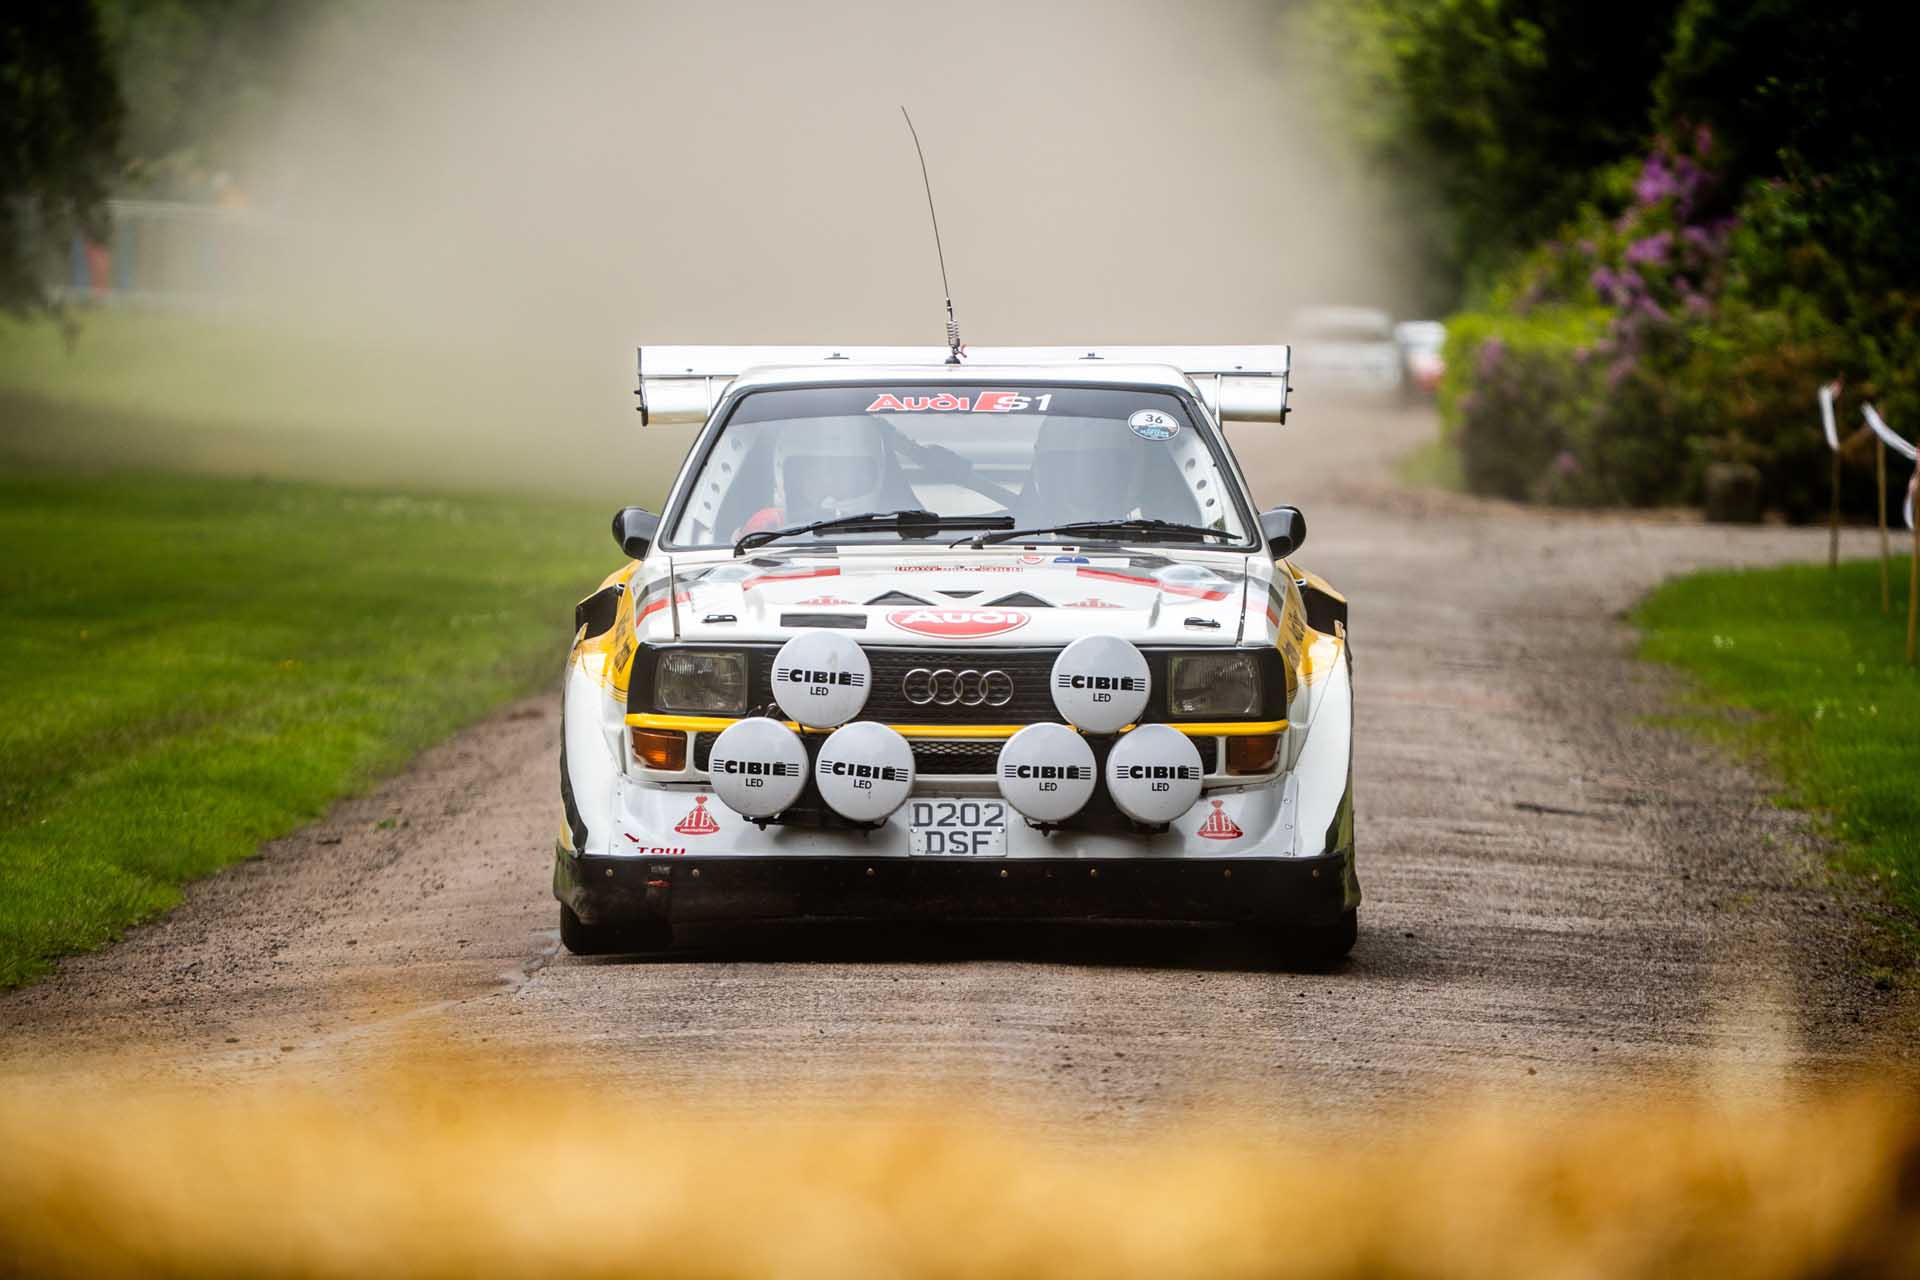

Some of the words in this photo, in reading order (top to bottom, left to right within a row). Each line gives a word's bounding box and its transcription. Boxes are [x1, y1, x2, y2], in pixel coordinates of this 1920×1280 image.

[866, 393, 969, 411] Audi
[1145, 414, 1163, 424] 36
[810, 686, 829, 696] LED
[1093, 693, 1111, 702] LED
[745, 779, 764, 787] LED
[853, 780, 872, 789] LED
[1039, 783, 1057, 791] LED
[1151, 783, 1169, 791] LED
[912, 803, 1004, 827] D202
[925, 831, 992, 854] DSF
